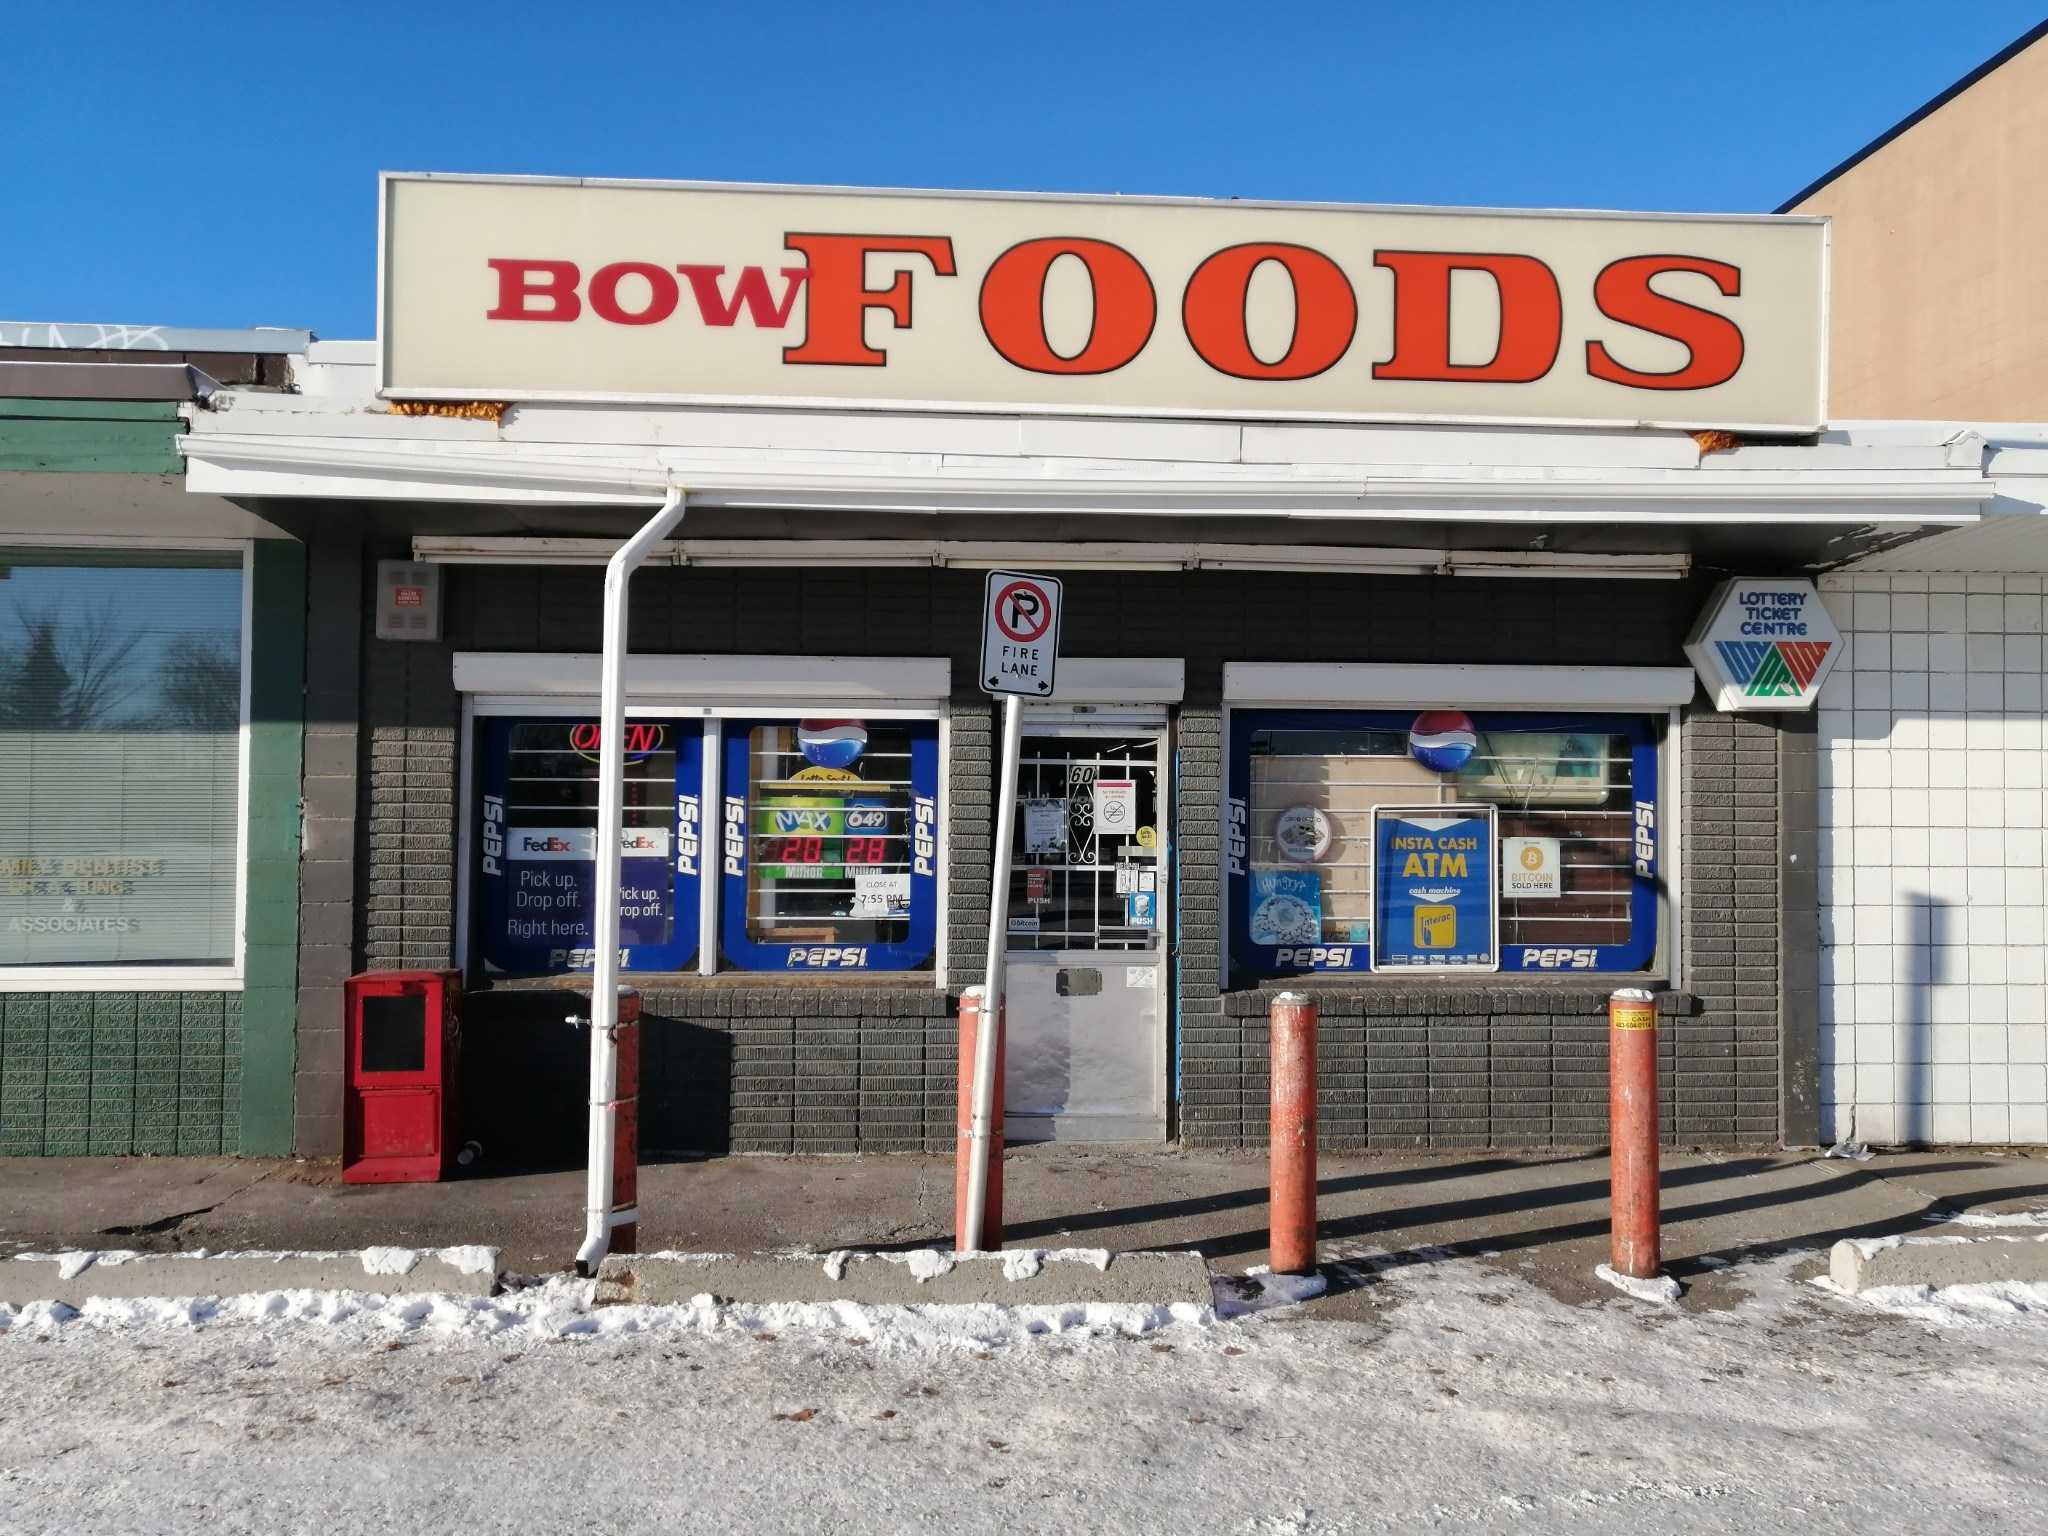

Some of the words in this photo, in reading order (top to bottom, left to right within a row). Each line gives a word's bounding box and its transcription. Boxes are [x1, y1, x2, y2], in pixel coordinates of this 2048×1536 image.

[486, 257, 808, 329] BOW
[783, 230, 1745, 391] FOODS
[1739, 591, 1808, 606] LOTTERY
[1745, 607, 1802, 621] TICKET
[1740, 621, 1808, 636] CENTRE
[1002, 645, 1039, 661] FIRE
[1001, 661, 1038, 677] LANE
[1070, 766, 1094, 783] 60
[482, 794, 504, 876] PEPSI
[523, 836, 571, 852] FedEx
[621, 836, 656, 849] edEx
[677, 794, 698, 876] PEPSI
[724, 796, 745, 877] PEPSI
[914, 796, 935, 877] PEPSI
[1228, 798, 1247, 876] PEPSI
[1391, 837, 1434, 850] INSTA
[1438, 837, 1477, 850] CASH
[1635, 801, 1654, 879] PEPSI
[782, 837, 823, 864] 20
[846, 837, 886, 864] 28
[1402, 852, 1468, 878] ATM
[520, 871, 551, 887] Pick
[555, 874, 578, 891] up.
[866, 881, 887, 889] CLOSE
[1511, 872, 1553, 882] BITCOIN
[618, 887, 639, 899] ick
[641, 890, 660, 902] up.
[861, 895, 883, 904] 7:55
[1408, 886, 1427, 894] cash
[1428, 886, 1461, 894] machine
[516, 891, 552, 910] Drop
[556, 891, 582, 908] off.
[620, 905, 640, 918] rop
[642, 903, 664, 917] off.
[8, 916, 129, 932] ASSOCIATES
[507, 919, 548, 939] Right
[551, 919, 589, 936] here.
[548, 948, 631, 968] PEPI
[787, 947, 868, 968] PEPSI
[1275, 947, 1354, 968] PEPSI
[1522, 948, 1598, 968] PEPSI
